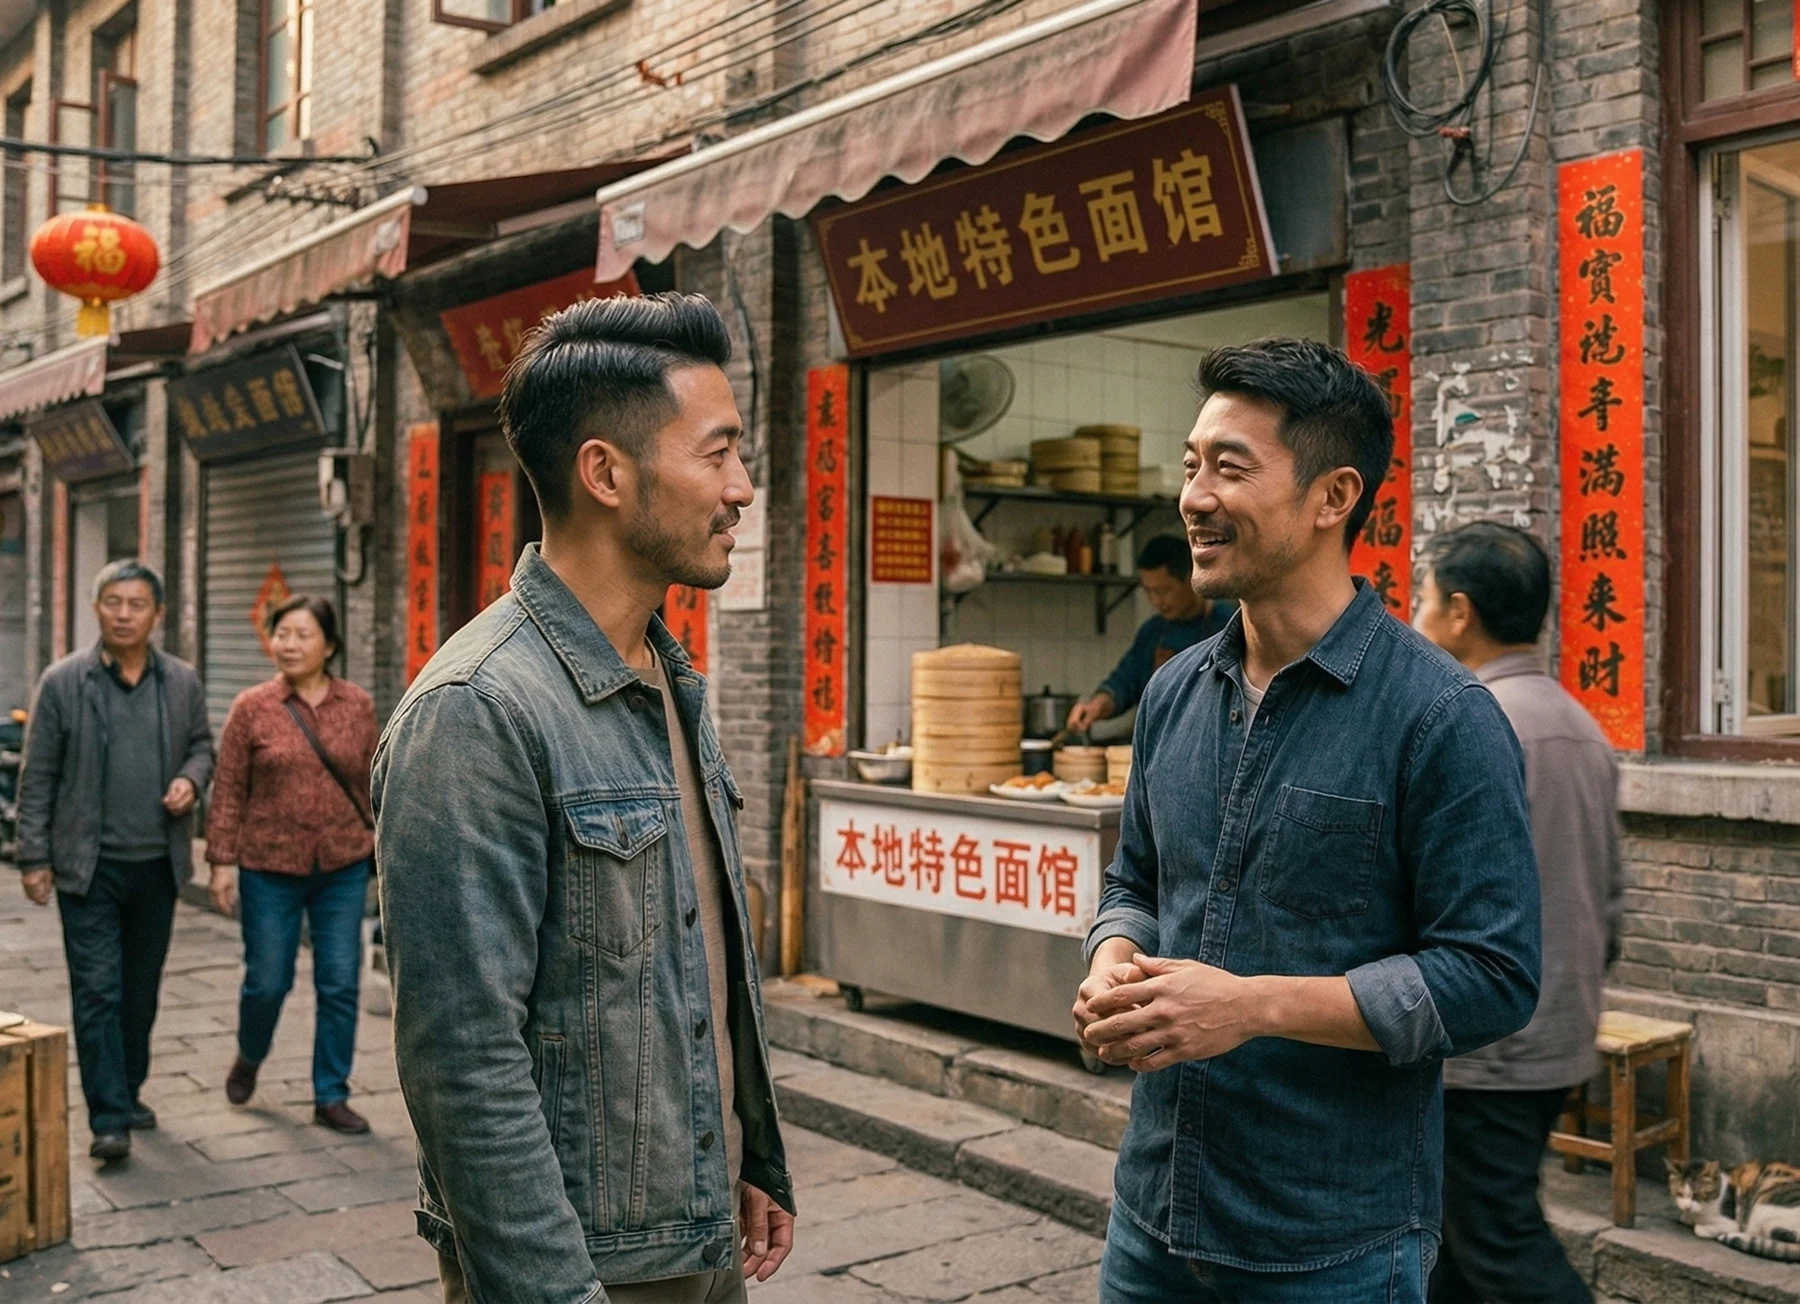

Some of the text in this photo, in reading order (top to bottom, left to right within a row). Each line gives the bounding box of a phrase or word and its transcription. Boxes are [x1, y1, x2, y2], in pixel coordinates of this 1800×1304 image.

[73, 224, 127, 275] 福
[847, 148, 1225, 314] 本地特色面馆
[836, 817, 1079, 917] 本地特色面馆
